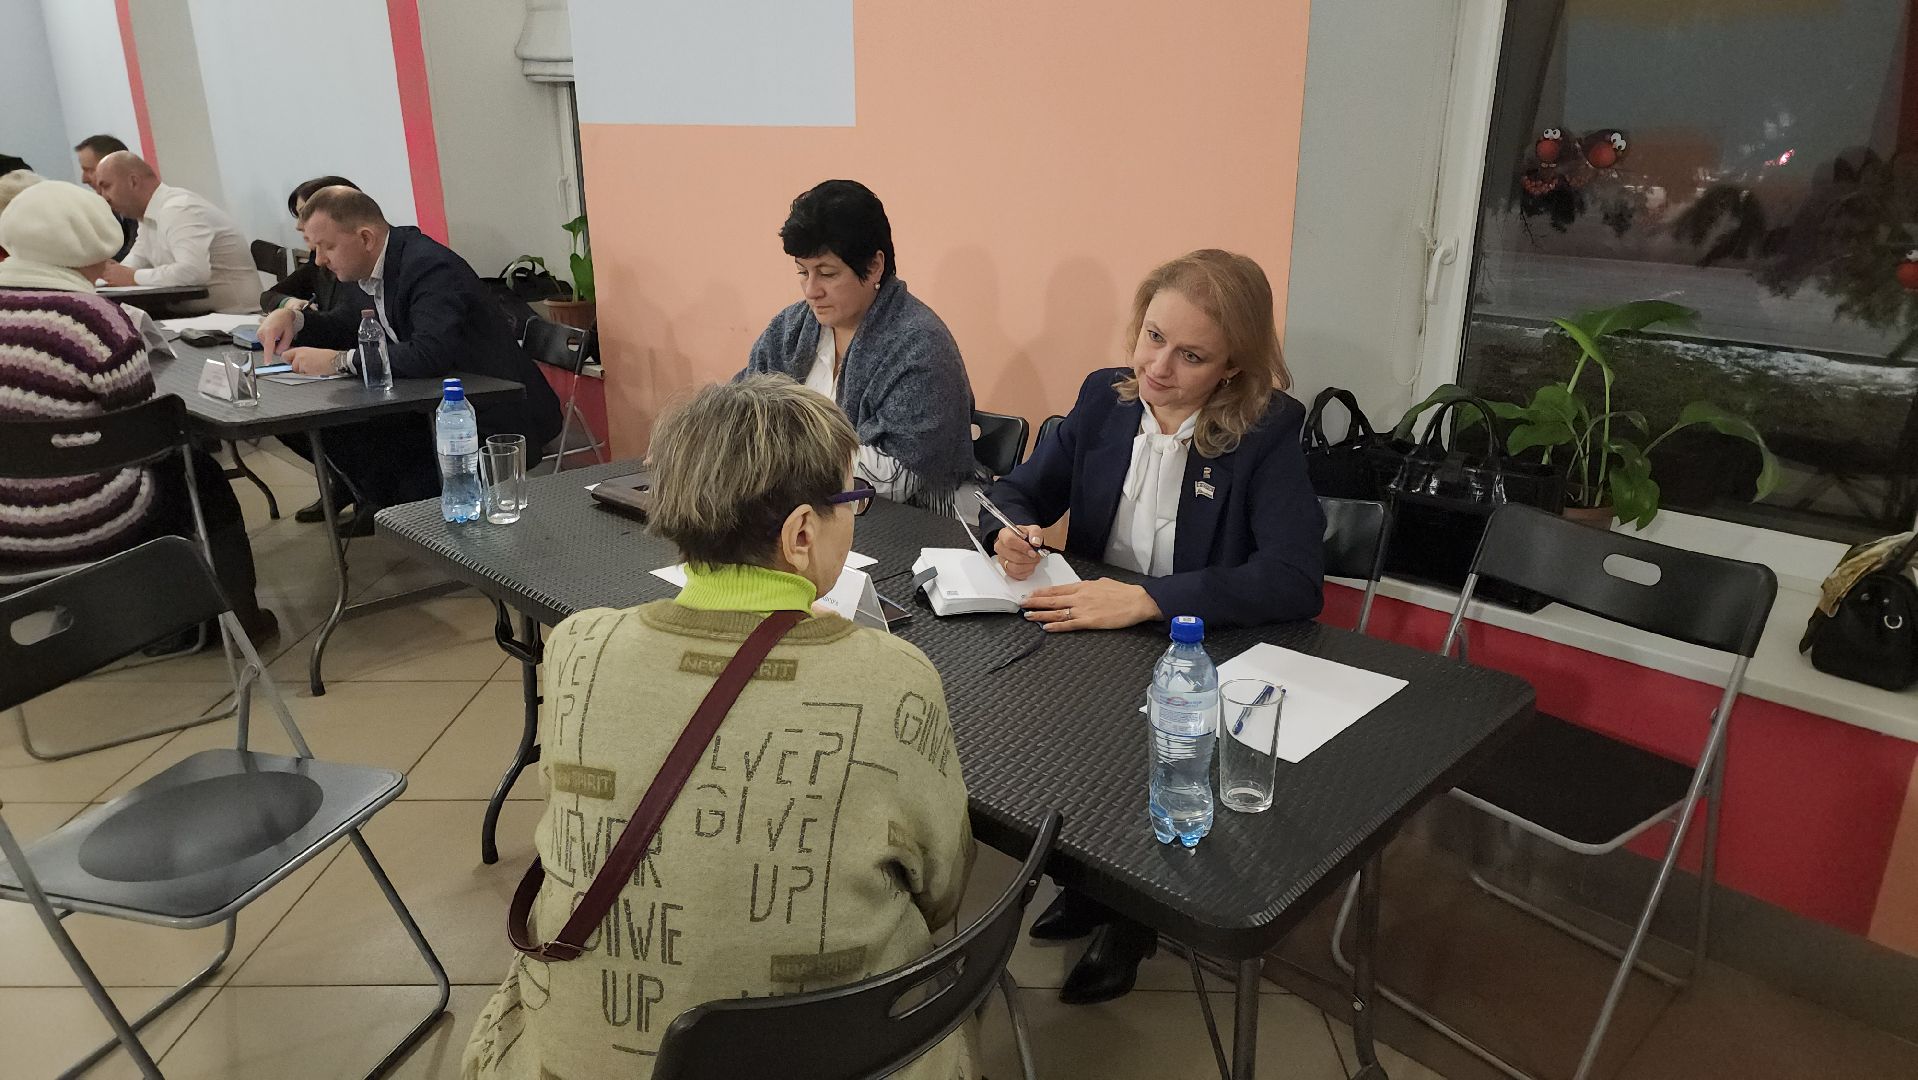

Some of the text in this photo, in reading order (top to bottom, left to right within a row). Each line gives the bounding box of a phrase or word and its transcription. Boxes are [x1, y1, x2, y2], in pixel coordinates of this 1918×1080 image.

[695, 783, 823, 854] GIVE
[749, 862, 815, 924] UP
[570, 890, 684, 966] IVE
[602, 968, 665, 1033] UP
